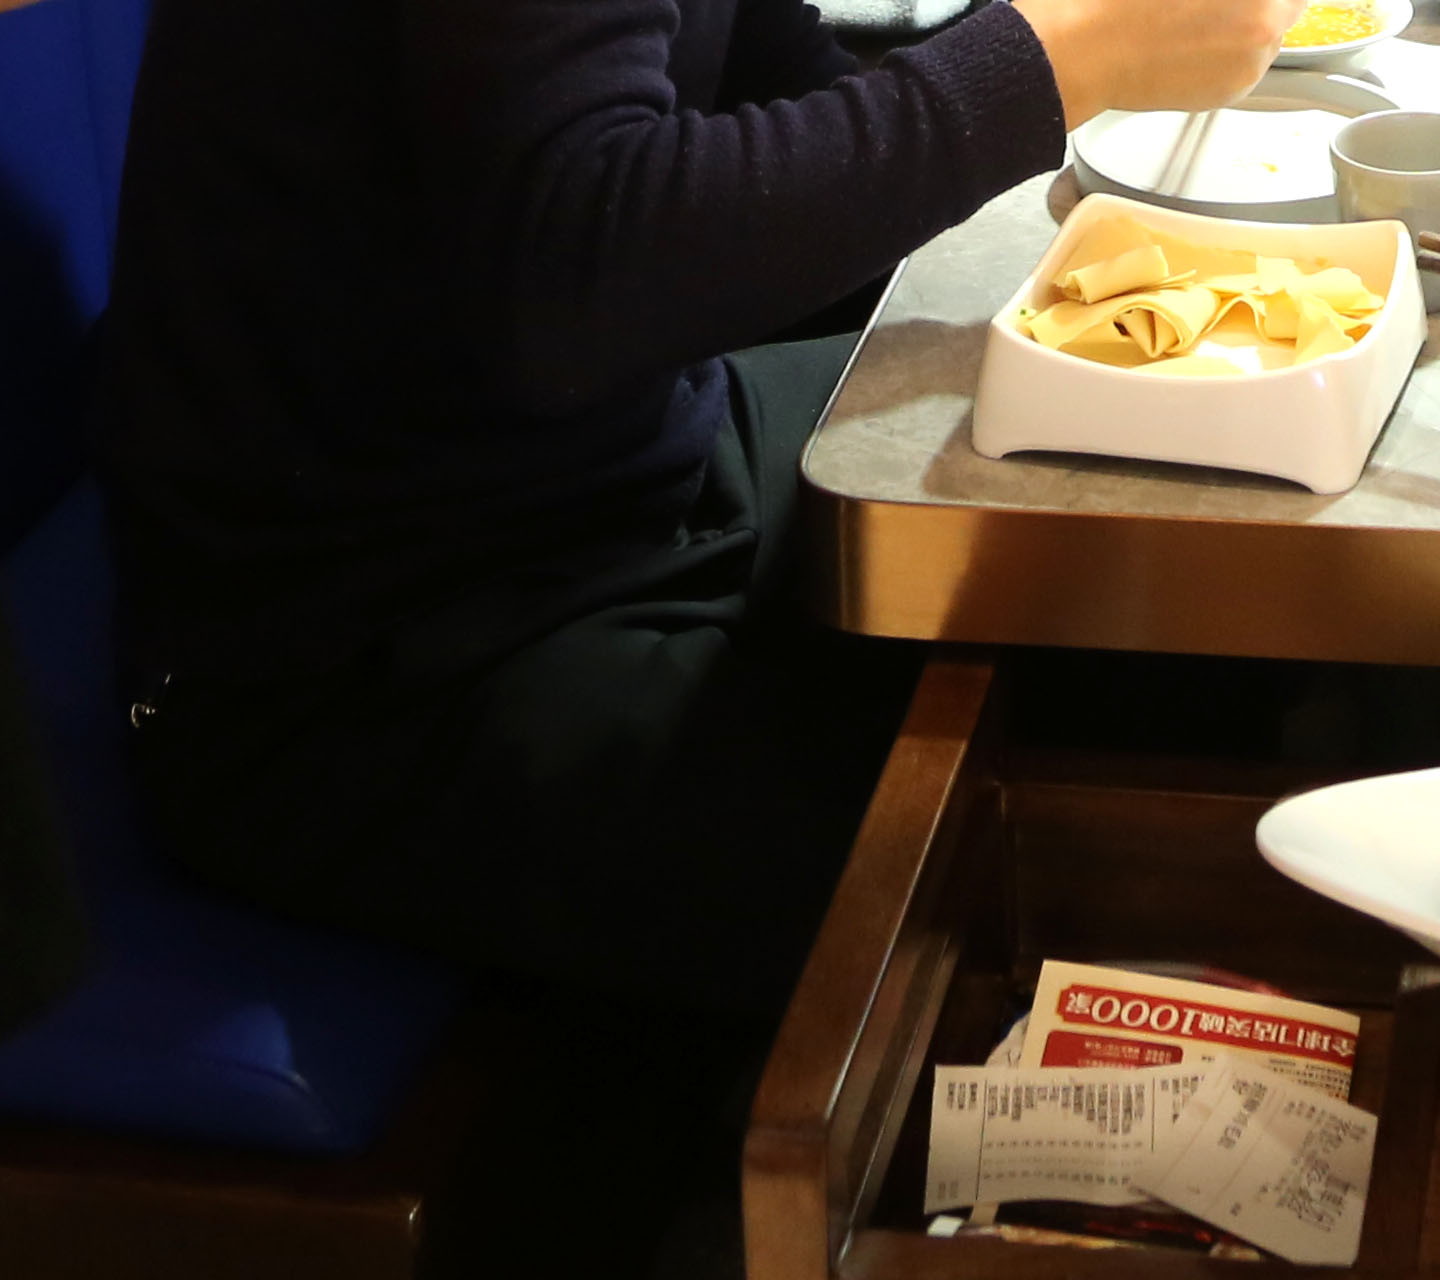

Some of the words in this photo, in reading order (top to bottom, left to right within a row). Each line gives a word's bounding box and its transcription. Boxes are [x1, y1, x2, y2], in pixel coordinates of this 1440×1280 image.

[1065, 992, 1356, 1057] 全球门店突破1000家
